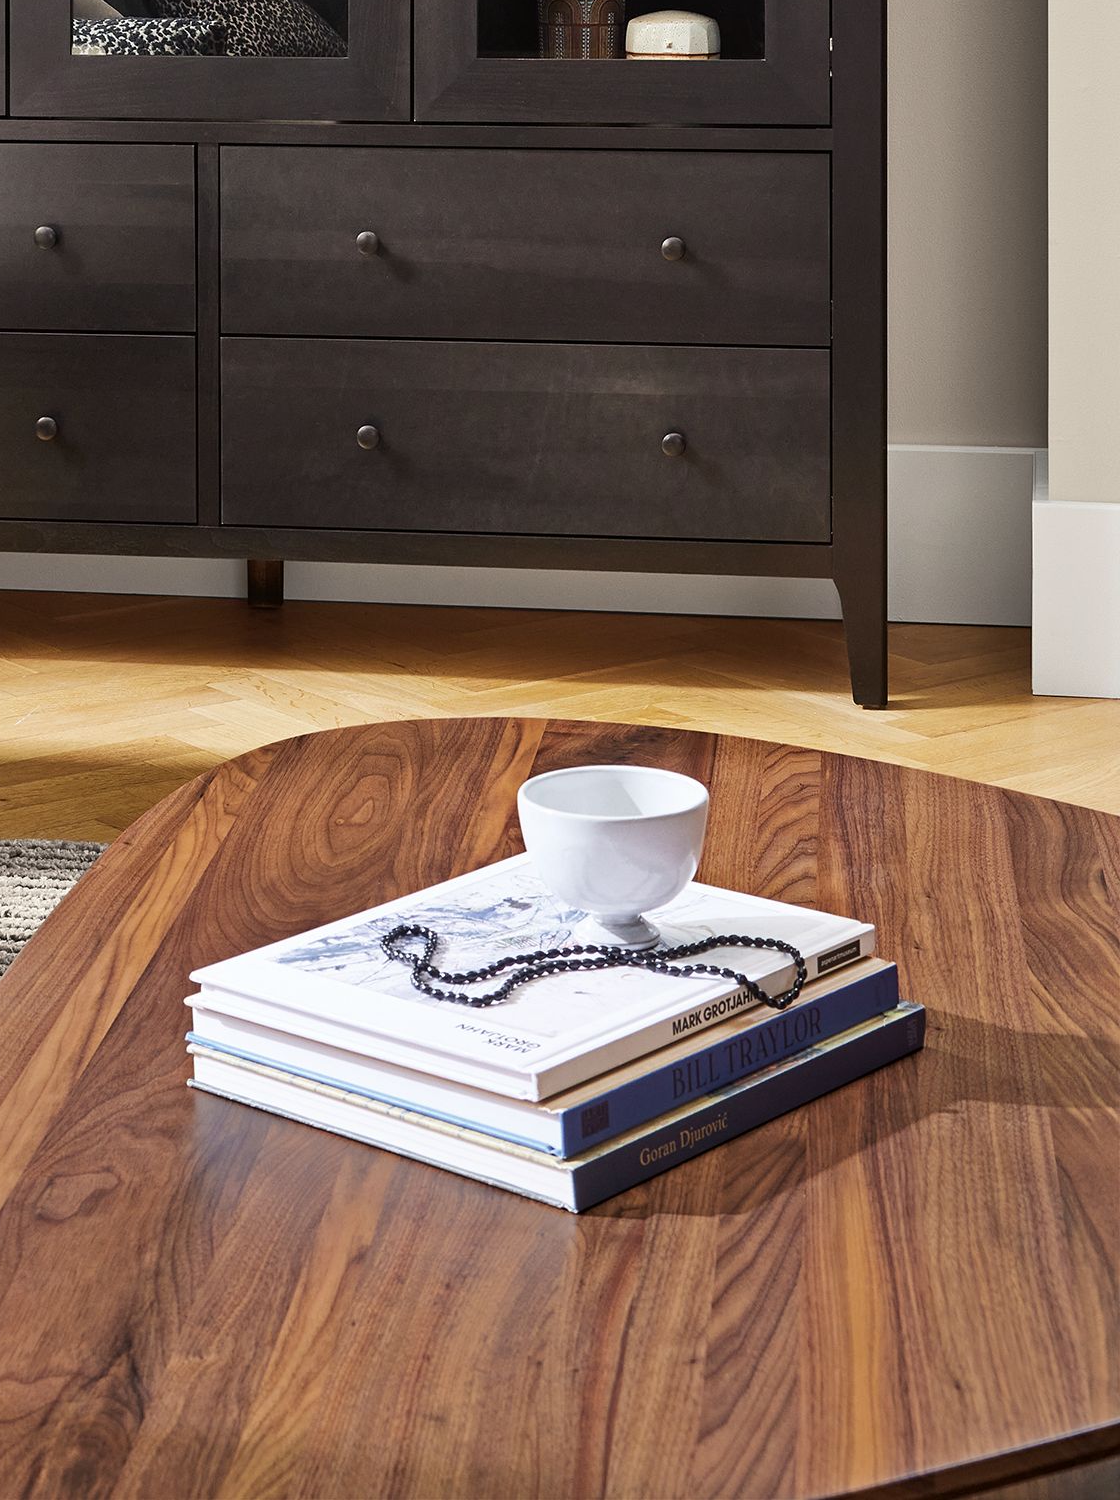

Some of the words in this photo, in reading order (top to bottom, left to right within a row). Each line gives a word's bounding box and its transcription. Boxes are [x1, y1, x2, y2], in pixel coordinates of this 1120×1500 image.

[456, 1023, 542, 1049] GROTJAHN
[672, 1013, 703, 1036] MARK
[484, 1038, 532, 1054] MARK
[671, 1050, 721, 1101] BILL
[727, 1006, 822, 1074] TRAYLOR
[639, 1140, 677, 1167] Goran
[679, 1112, 729, 1147] Djurović
